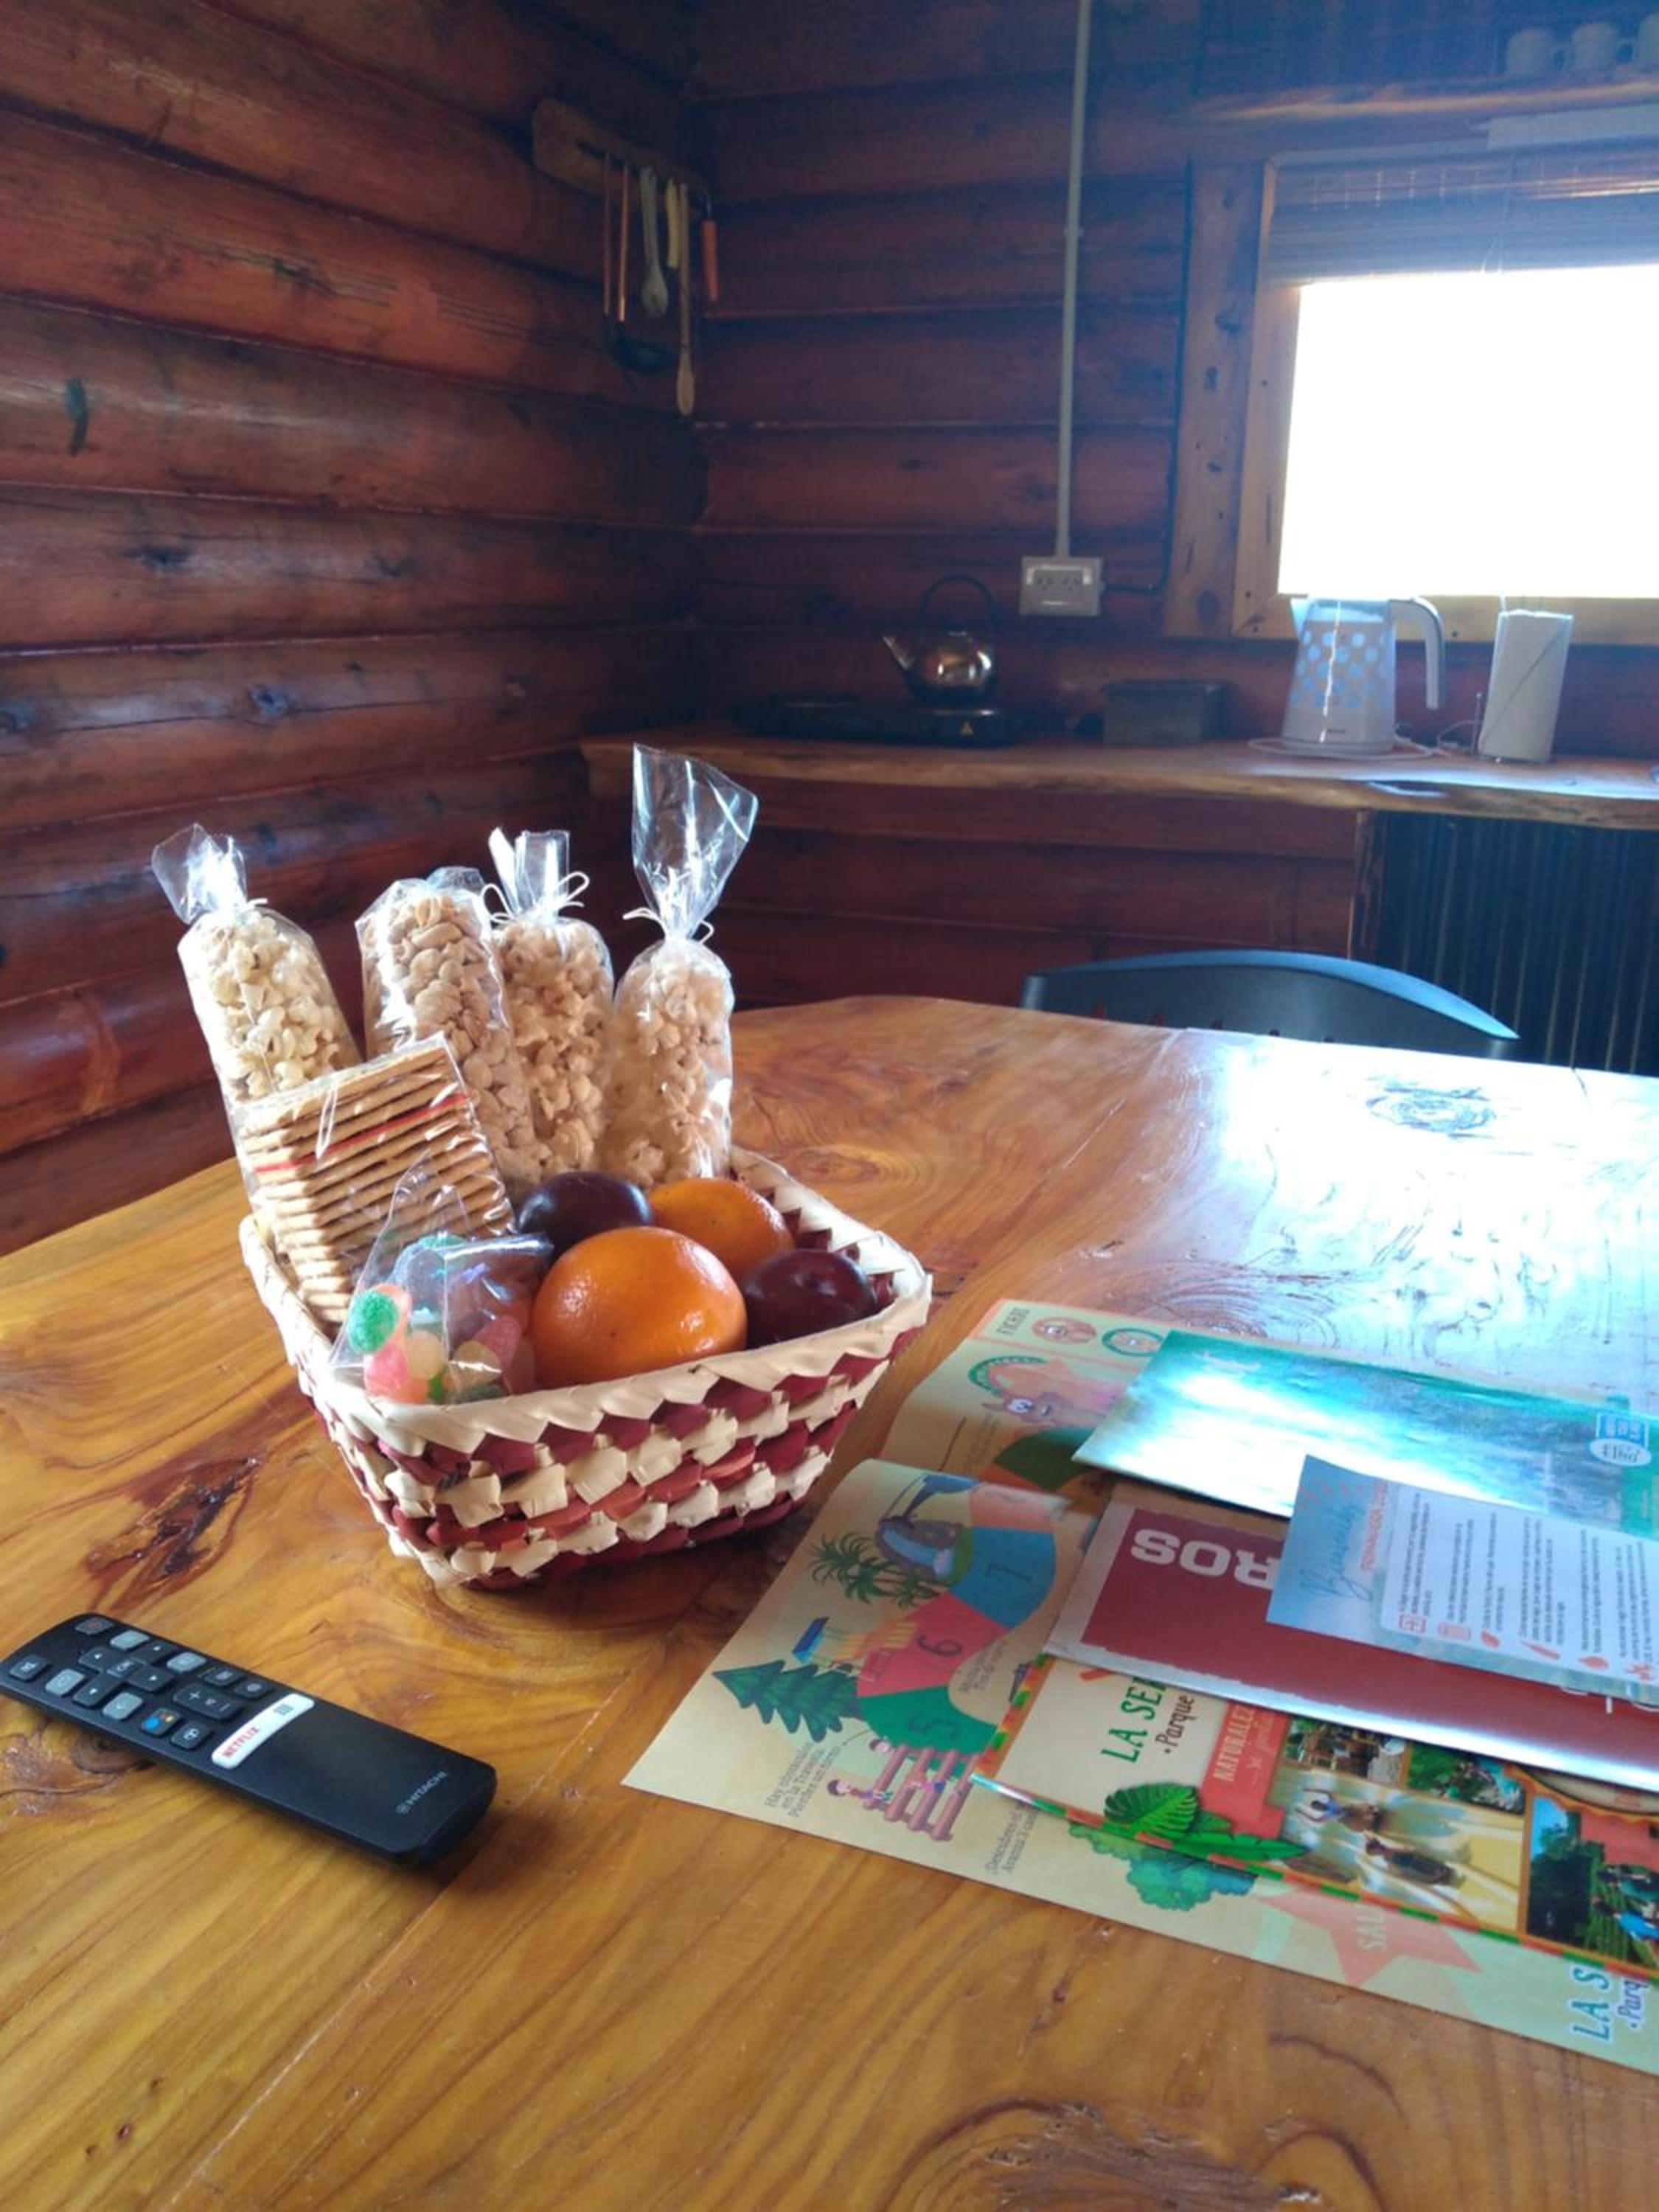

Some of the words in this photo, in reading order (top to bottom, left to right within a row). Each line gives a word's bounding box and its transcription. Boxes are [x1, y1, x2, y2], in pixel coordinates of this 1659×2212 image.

[221, 1726, 260, 1759] NETFLIX
[1101, 1728, 1149, 1763] LA
[404, 1770, 448, 1806] HITACHI
[1571, 2000, 1610, 2041] LA
